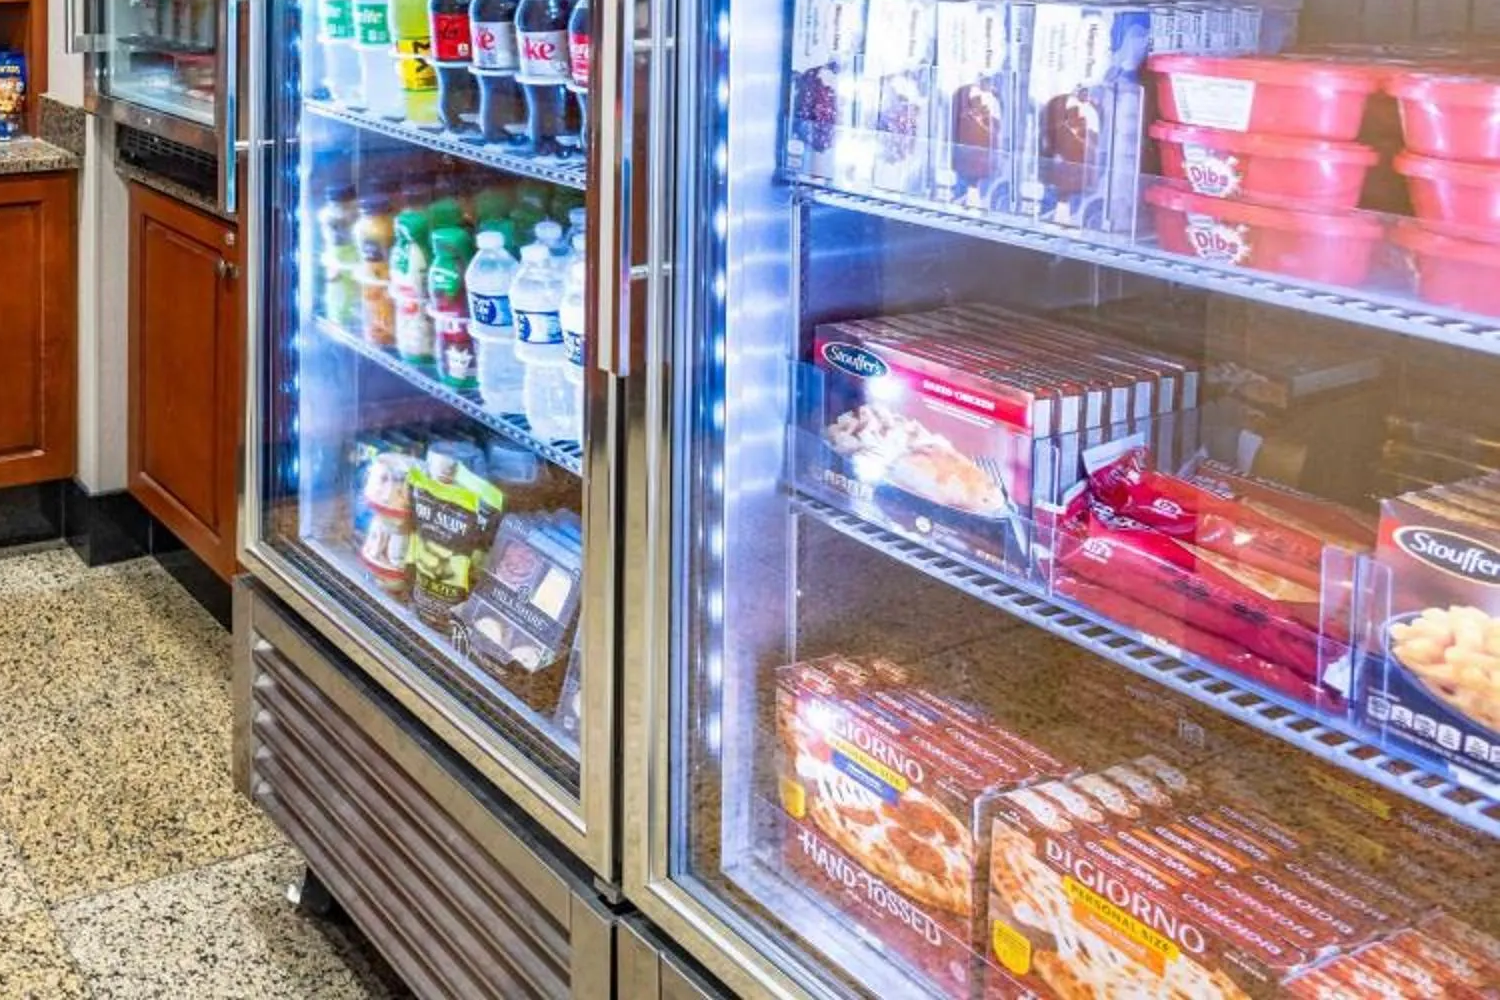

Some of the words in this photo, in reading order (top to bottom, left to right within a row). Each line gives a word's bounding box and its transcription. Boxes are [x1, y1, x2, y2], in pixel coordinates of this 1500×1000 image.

[1189, 165, 1230, 187] Dibs
[1194, 231, 1239, 254] Dibs
[797, 831, 942, 947] HAND-TOSSED
